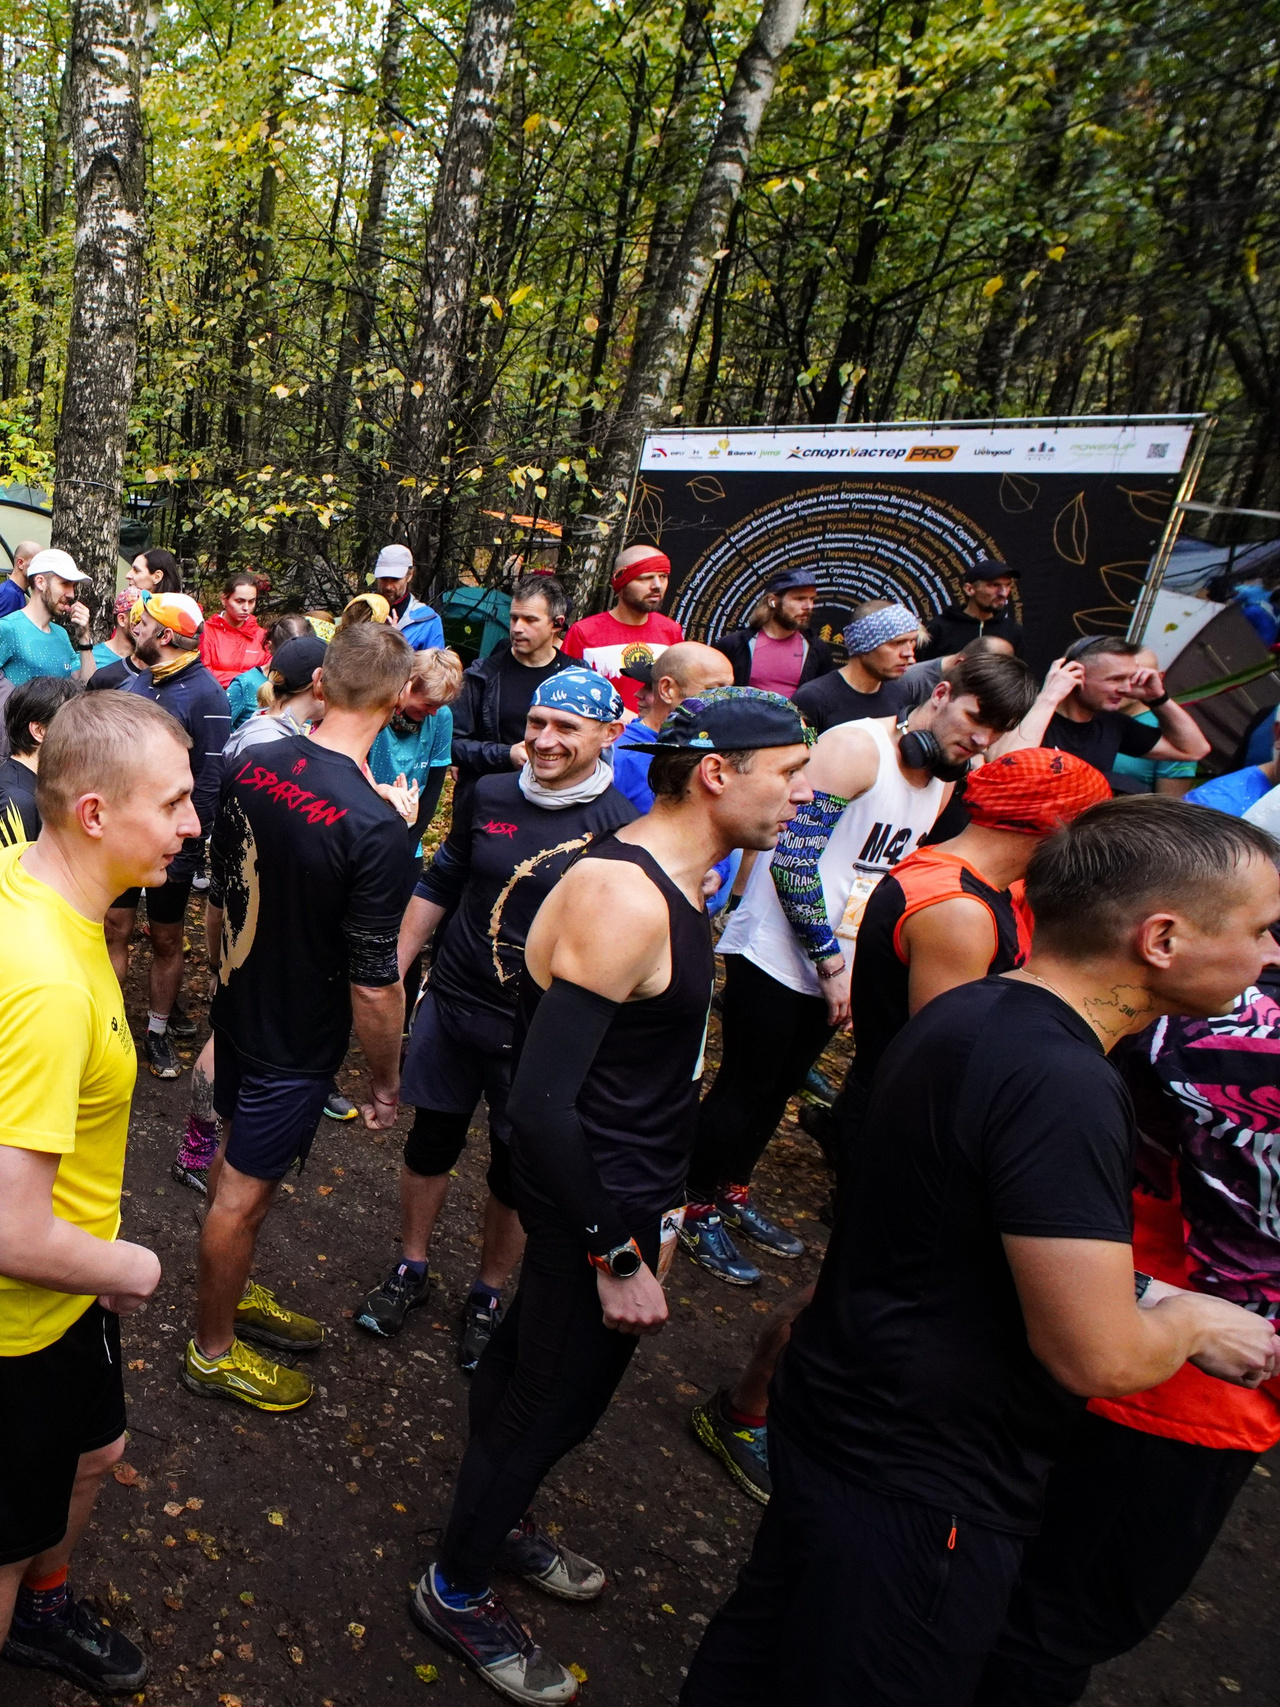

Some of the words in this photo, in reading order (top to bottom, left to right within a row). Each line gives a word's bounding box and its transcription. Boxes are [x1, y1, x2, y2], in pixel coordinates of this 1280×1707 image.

[909, 448, 954, 460] PRO
[725, 513, 754, 535] Азарова
[754, 494, 794, 515] Екатерина
[795, 483, 839, 498] Айзенберг
[840, 481, 873, 490] Леонид
[874, 482, 911, 495] Аксютин
[849, 511, 870, 519] Иван
[851, 502, 877, 510] Гуськов
[789, 525, 822, 539] Татьяна
[827, 522, 870, 531] Кузьмина
[690, 559, 712, 589] Горбунов
[710, 542, 730, 562] Вадим
[730, 525, 751, 543] Белый
[751, 508, 782, 527] Виталий
[784, 497, 817, 512] Боброва
[818, 493, 839, 502] Анна
[840, 492, 889, 501] Борисенков
[890, 495, 923, 511] Виталий
[923, 506, 955, 529] Бровкин
[954, 525, 978, 549] Сергей
[239, 766, 350, 827] SPARTAN
[481, 819, 519, 839] MSR
